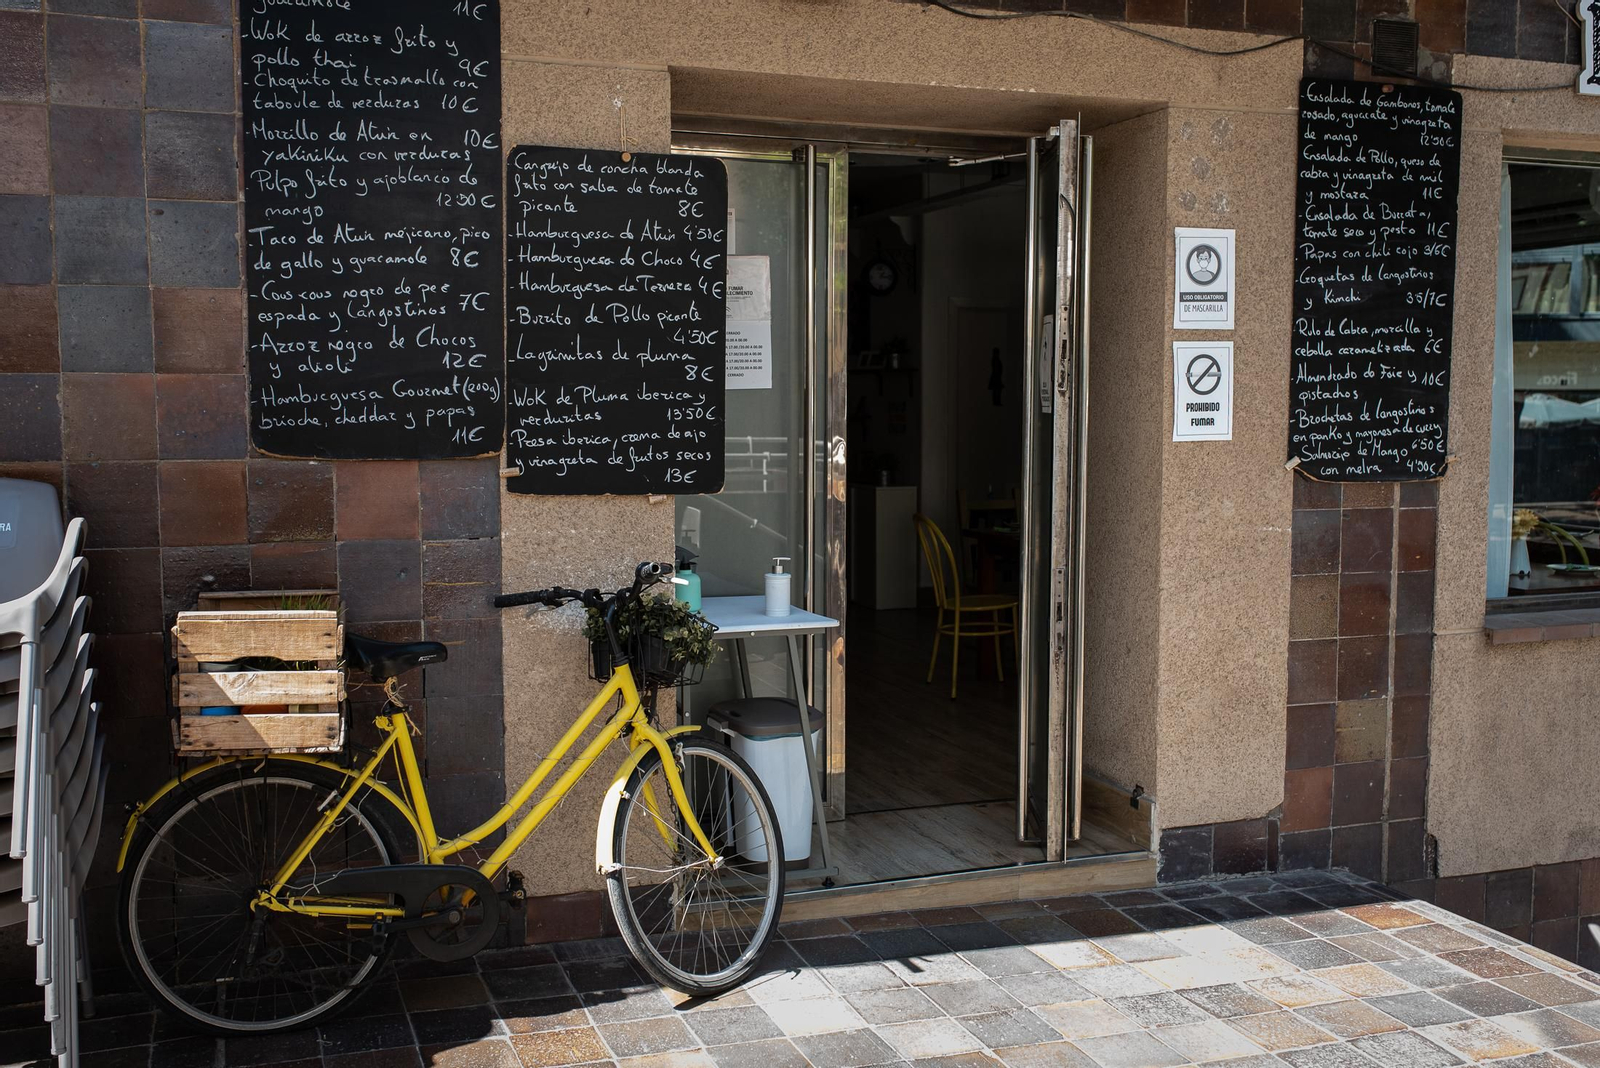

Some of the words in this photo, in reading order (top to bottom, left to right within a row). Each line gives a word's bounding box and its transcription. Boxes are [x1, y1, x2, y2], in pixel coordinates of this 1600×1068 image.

[453, 0, 487, 20] 11€
[306, 20, 323, 42] de
[335, 33, 381, 44] arroz
[391, 24, 435, 54] frito
[446, 40, 458, 56] y
[251, 47, 299, 71] pollo
[313, 49, 356, 68] thai
[459, 59, 488, 77] 9€
[255, 67, 330, 93] Choquito
[341, 70, 358, 86] de
[364, 66, 445, 85] trasmallo
[453, 80, 478, 88] con
[328, 90, 343, 108] de
[353, 90, 419, 109] verduras
[1307, 82, 1354, 104] Ensalada
[1360, 88, 1371, 106] de
[1425, 97, 1455, 113] tomate
[253, 118, 318, 140] Morrillo
[329, 121, 346, 141] de
[409, 132, 432, 141] en
[464, 129, 498, 149] 10€
[1342, 108, 1388, 128] aguacate
[1390, 116, 1398, 130] y
[1402, 116, 1451, 136] vinagreta
[1304, 124, 1316, 139] de
[1324, 134, 1357, 147] mango
[359, 152, 387, 160] con
[395, 145, 470, 161] verduras
[1303, 144, 1351, 162] Ensalada
[1356, 146, 1366, 162] de
[1401, 158, 1424, 169] queso
[1429, 153, 1441, 167] de
[578, 155, 593, 172] de
[601, 158, 648, 174] concha
[657, 159, 704, 178] blanda
[1301, 165, 1329, 178] cabra
[1331, 172, 1339, 188] y
[1343, 167, 1394, 189] vinagreta
[1402, 169, 1413, 181] de
[251, 170, 297, 197] Pulpo
[305, 165, 347, 199] frito
[356, 179, 367, 196] y
[374, 165, 449, 191] ajoblanco
[459, 163, 477, 185] de
[581, 178, 617, 193] salsa
[627, 178, 642, 193] de
[649, 177, 697, 195] tomate
[1305, 191, 1312, 204] y
[1320, 182, 1369, 199] mostaza
[1423, 187, 1442, 199] 11€
[265, 206, 323, 225] mango
[519, 194, 577, 218] picante
[679, 200, 703, 217] 8€
[1306, 203, 1358, 221] Ensalada
[1363, 205, 1375, 220] de
[249, 226, 296, 246] Taco
[307, 227, 323, 244] de
[460, 226, 490, 244] pico
[516, 218, 614, 248] Hamburguesa
[620, 219, 634, 239] de
[1303, 221, 1337, 239] tomate
[1344, 228, 1364, 237] seco
[1368, 230, 1376, 245] y
[1380, 221, 1415, 240] pesto
[1428, 222, 1450, 238] 11€
[254, 250, 271, 270] de
[281, 250, 323, 278] gallo
[332, 258, 343, 274] y
[350, 246, 427, 273] guacamole
[450, 247, 479, 267] 8€
[518, 243, 614, 271] Hamburguesa
[620, 246, 634, 266] de
[642, 249, 682, 266] Choco
[1300, 243, 1336, 263] Papas
[1365, 242, 1390, 257] chili
[519, 271, 613, 299] Hamburguesa
[618, 278, 637, 292] de
[636, 275, 691, 292] Ternera
[1300, 266, 1354, 288] Croquetas
[1362, 265, 1372, 281] de
[343, 287, 383, 307] negro
[395, 277, 411, 294] de
[459, 292, 490, 311] 7€
[1304, 298, 1312, 310] y
[258, 304, 320, 328] espada
[329, 312, 340, 332] y
[516, 304, 570, 325] Burrito
[585, 303, 603, 323] de
[606, 303, 650, 323] Pollo
[657, 300, 701, 329] picante
[1184, 304, 1191, 313] DE
[1192, 304, 1224, 313] MASCARILLA
[1296, 318, 1320, 336] Rulo
[1325, 319, 1335, 336] de
[1427, 327, 1433, 337] y
[260, 332, 320, 355] Arroz
[328, 340, 372, 362] negro
[389, 325, 404, 348] de
[612, 339, 629, 360] de
[637, 339, 695, 367] pluma
[1295, 341, 1333, 356] cebolla
[1424, 338, 1443, 353] 6€
[270, 363, 281, 378] y
[298, 355, 352, 373] alioli
[443, 351, 486, 369] 12€
[685, 365, 713, 381] 8€
[1296, 362, 1357, 383] Almendrado
[1364, 362, 1375, 378] de
[1408, 370, 1417, 383] y
[1422, 371, 1445, 386] 10€
[262, 384, 383, 410] Hamburguesa
[556, 386, 573, 405] de
[574, 385, 628, 403] Pluma
[1299, 383, 1358, 406] pistachos
[335, 405, 396, 424] cheddar
[405, 412, 415, 429] y
[426, 406, 474, 427] papas
[520, 405, 601, 426] verduritas
[1186, 402, 1220, 412] PROHIBIDO
[1295, 404, 1353, 428] Brochetas
[1360, 402, 1371, 421] de
[1191, 418, 1215, 427] FUMAR
[1343, 432, 1352, 445] y
[1356, 428, 1401, 444] mayonesa
[1403, 418, 1413, 433] de
[1416, 424, 1442, 439] curry
[452, 426, 485, 444] 11€
[511, 429, 556, 448] Presa
[622, 433, 661, 442] crema
[668, 424, 680, 438] de
[684, 430, 706, 443] ajo
[516, 458, 524, 475] y
[529, 449, 598, 476] vinagreta
[608, 451, 623, 464] de
[626, 445, 668, 472] frutos
[676, 451, 711, 460] secos
[1358, 441, 1367, 455] de
[1372, 439, 1408, 463] Mango
[665, 468, 696, 483] 13€
[1321, 467, 1339, 475] con
